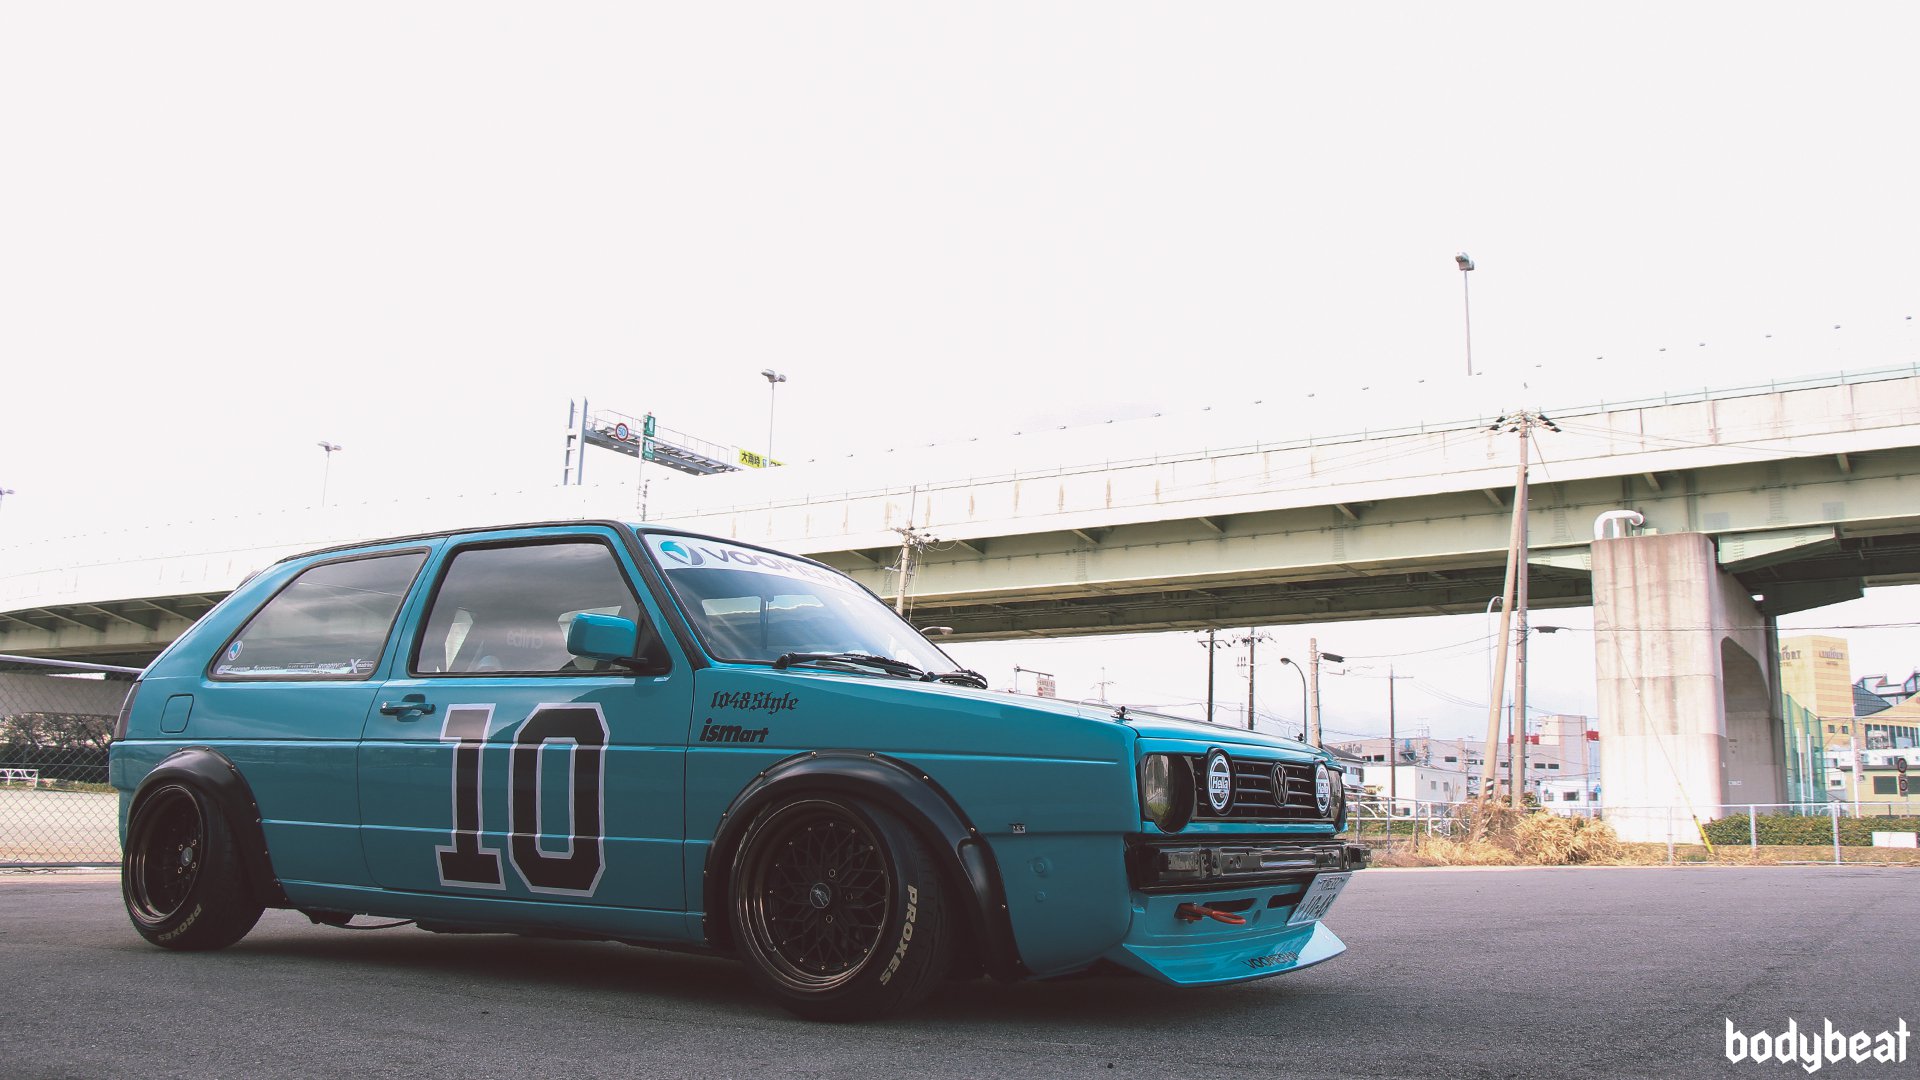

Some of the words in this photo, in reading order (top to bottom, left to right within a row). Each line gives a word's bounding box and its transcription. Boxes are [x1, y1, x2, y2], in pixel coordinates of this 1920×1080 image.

[435, 702, 611, 897] 10
[158, 903, 203, 942] PROXES
[879, 884, 918, 986] PROXES
